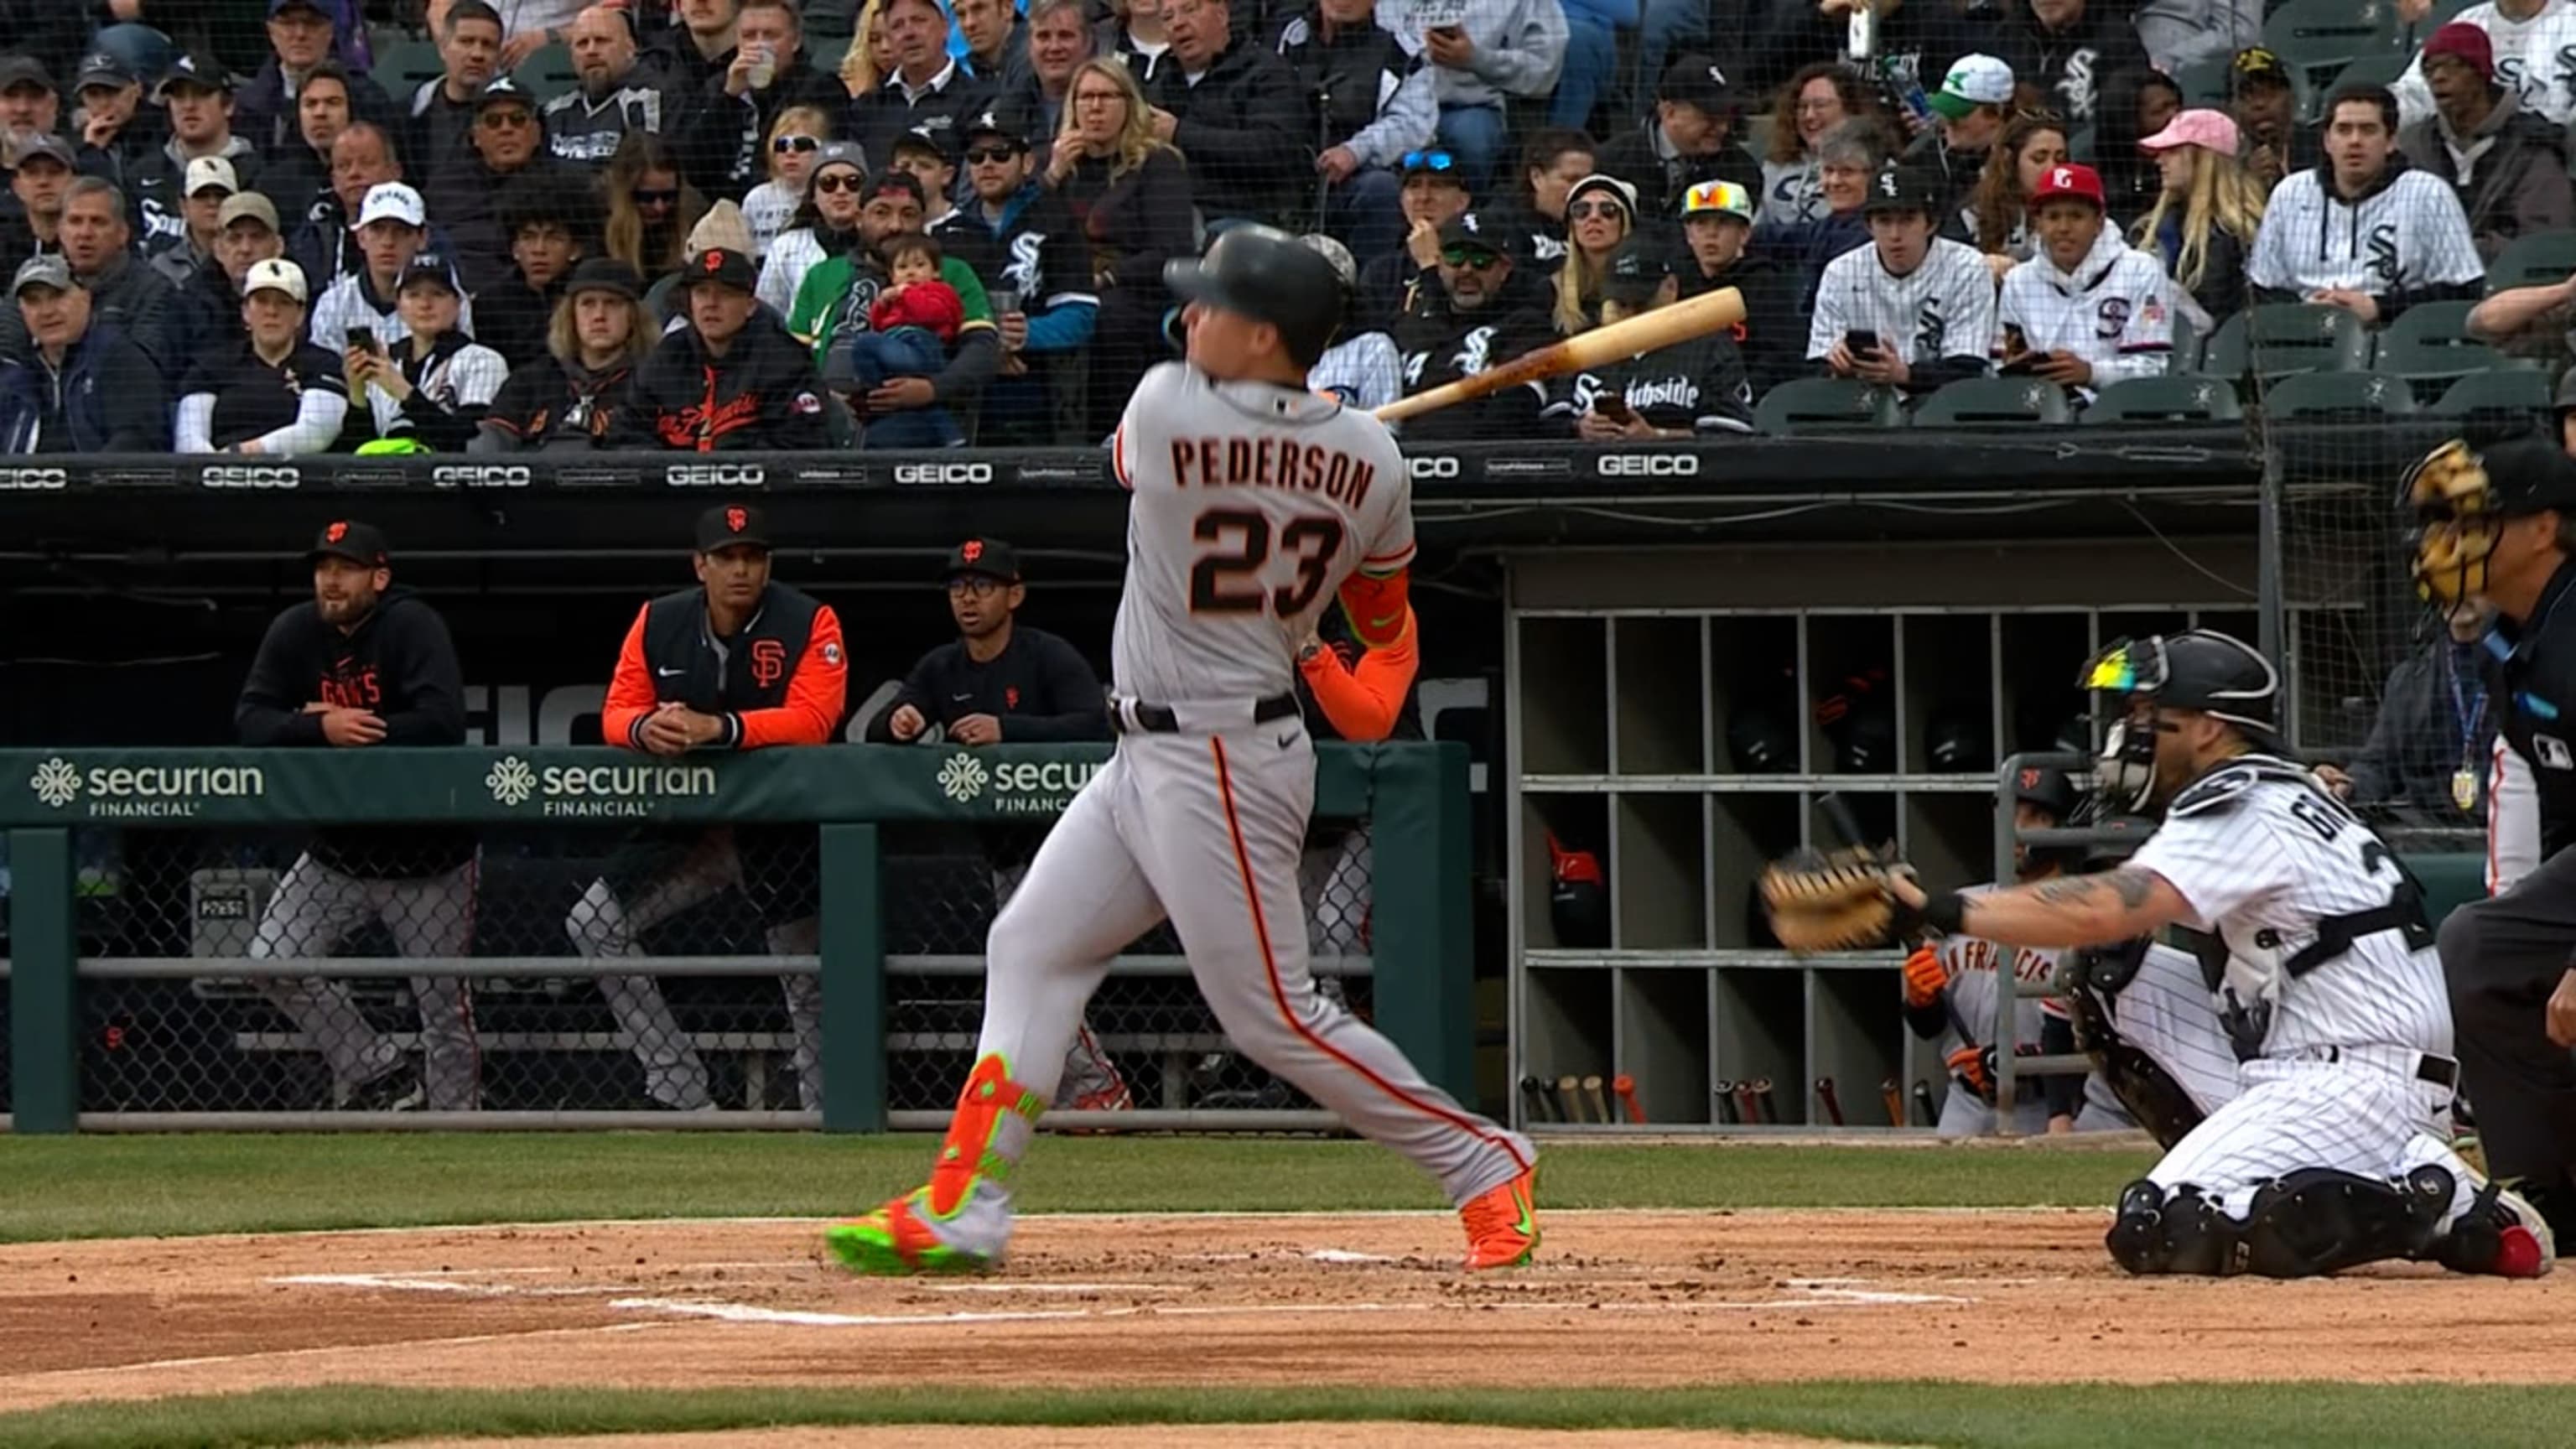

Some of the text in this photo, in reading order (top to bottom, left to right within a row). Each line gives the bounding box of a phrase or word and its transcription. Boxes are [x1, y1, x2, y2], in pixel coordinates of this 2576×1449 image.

[202, 467, 299, 488] GEICO
[433, 466, 530, 486] GEICO
[667, 465, 764, 486] GEICO
[895, 464, 992, 484] GEICO
[1171, 435, 1374, 509] PEDERSON
[1597, 455, 1698, 475] GEICO
[1189, 506, 1343, 619] 23
[752, 640, 787, 688] SF
[88, 766, 263, 796] securian
[543, 766, 715, 795] securian
